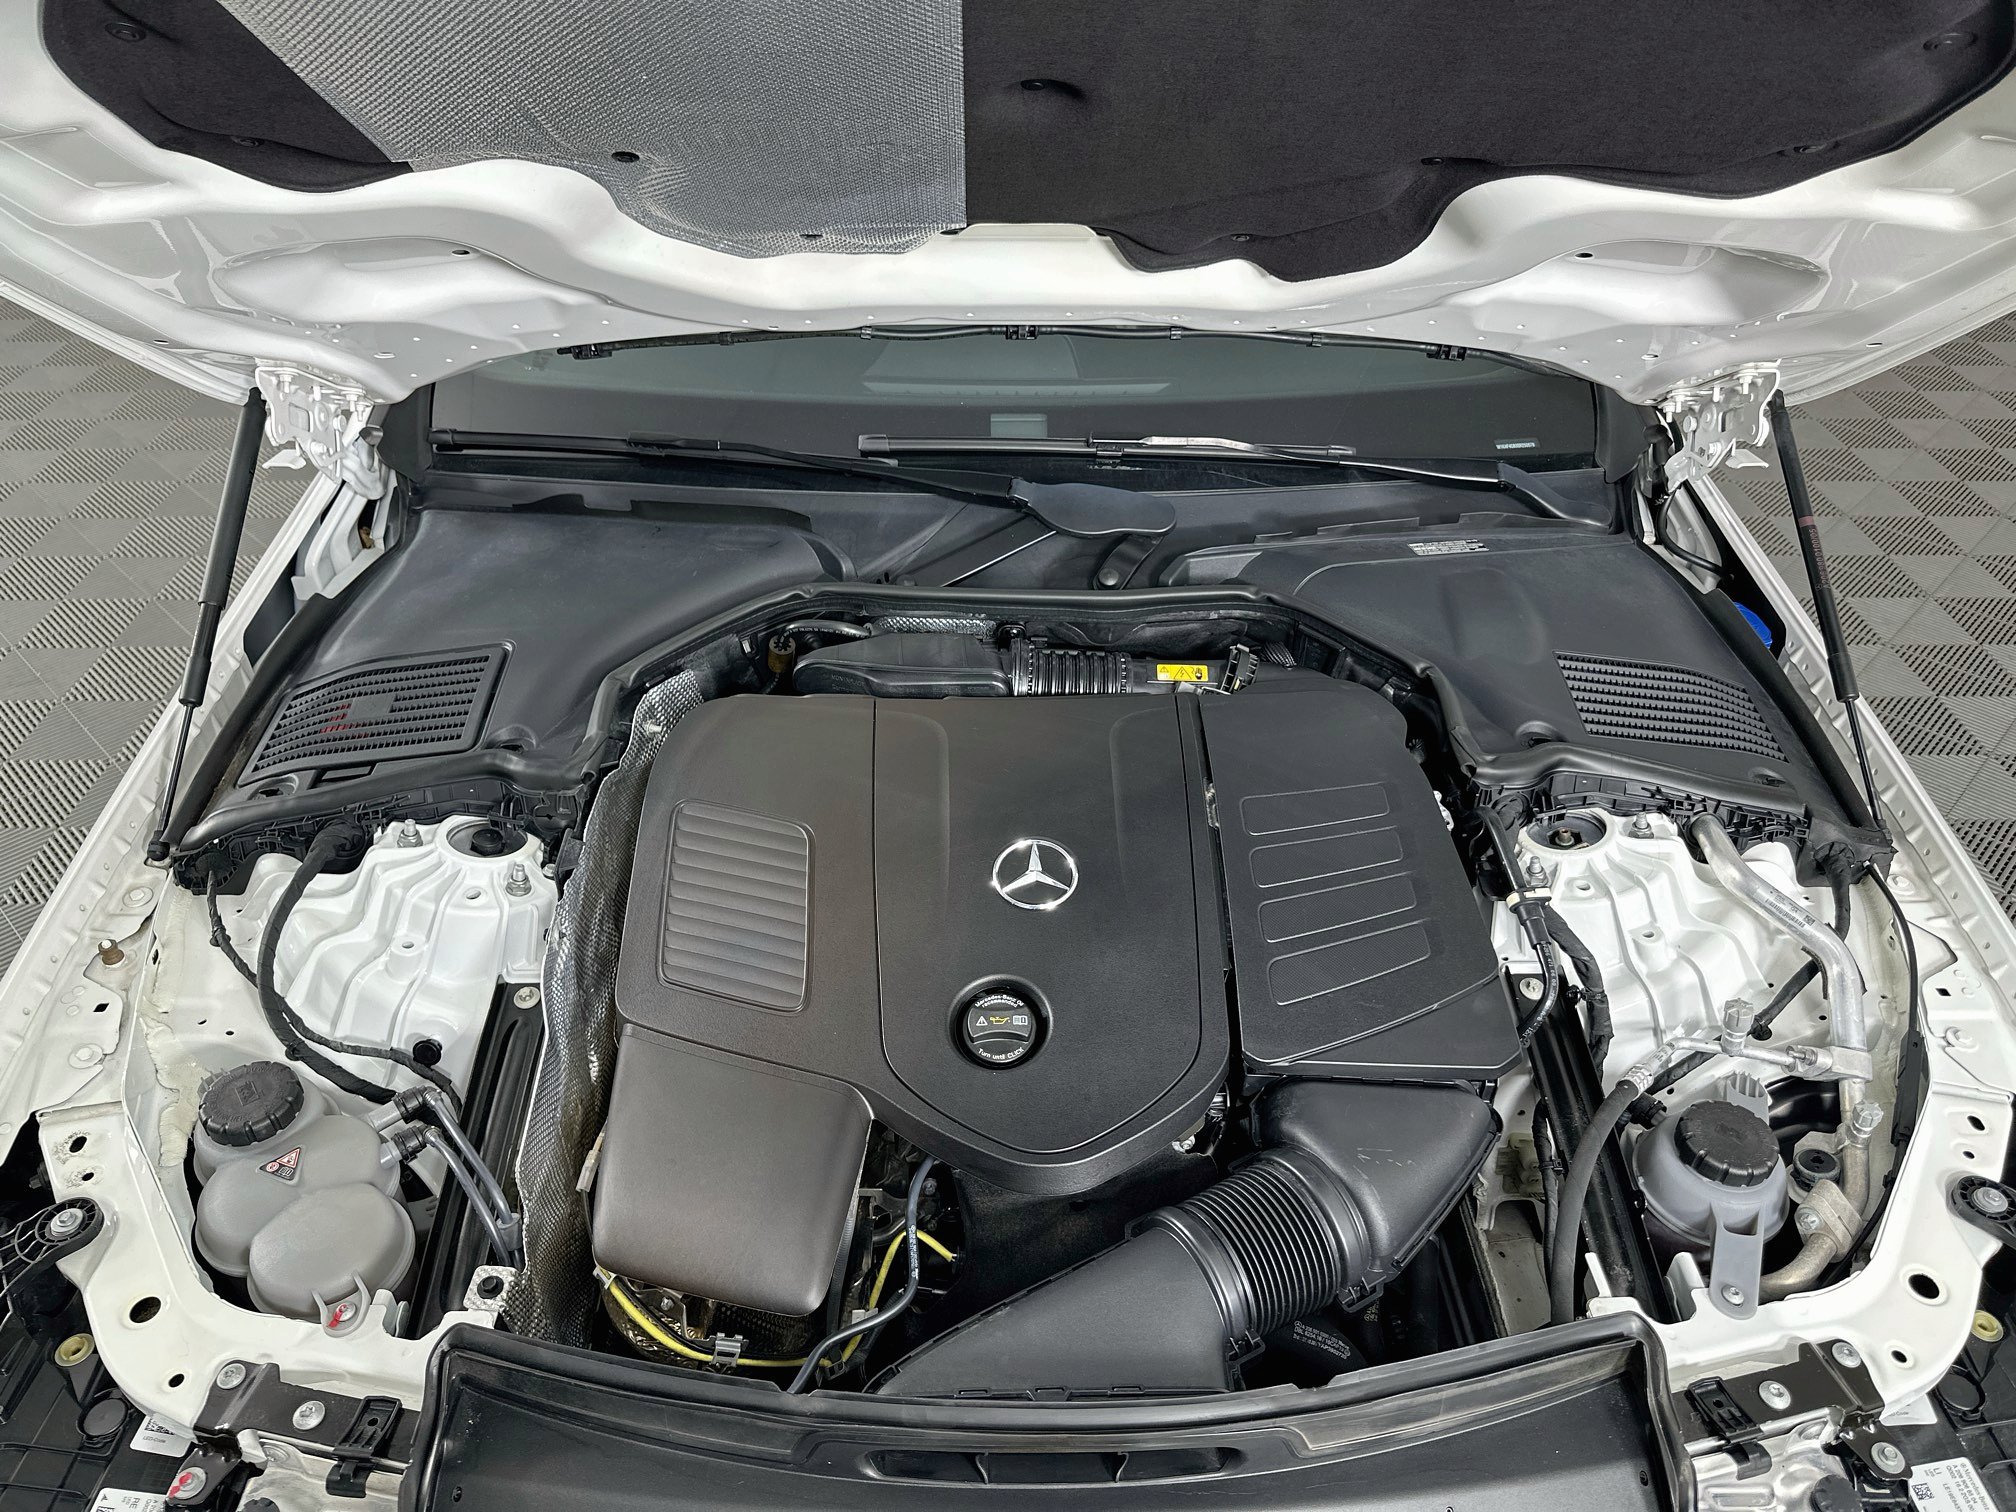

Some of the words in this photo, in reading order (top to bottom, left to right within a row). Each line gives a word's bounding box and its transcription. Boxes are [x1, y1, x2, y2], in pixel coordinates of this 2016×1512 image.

[974, 994, 1017, 1007] Mercedes-Benz
[978, 1047, 991, 1058] Turn
[1007, 1046, 1025, 1059] CLICK
[1964, 1468, 1990, 1511] Mercedes-Benz
